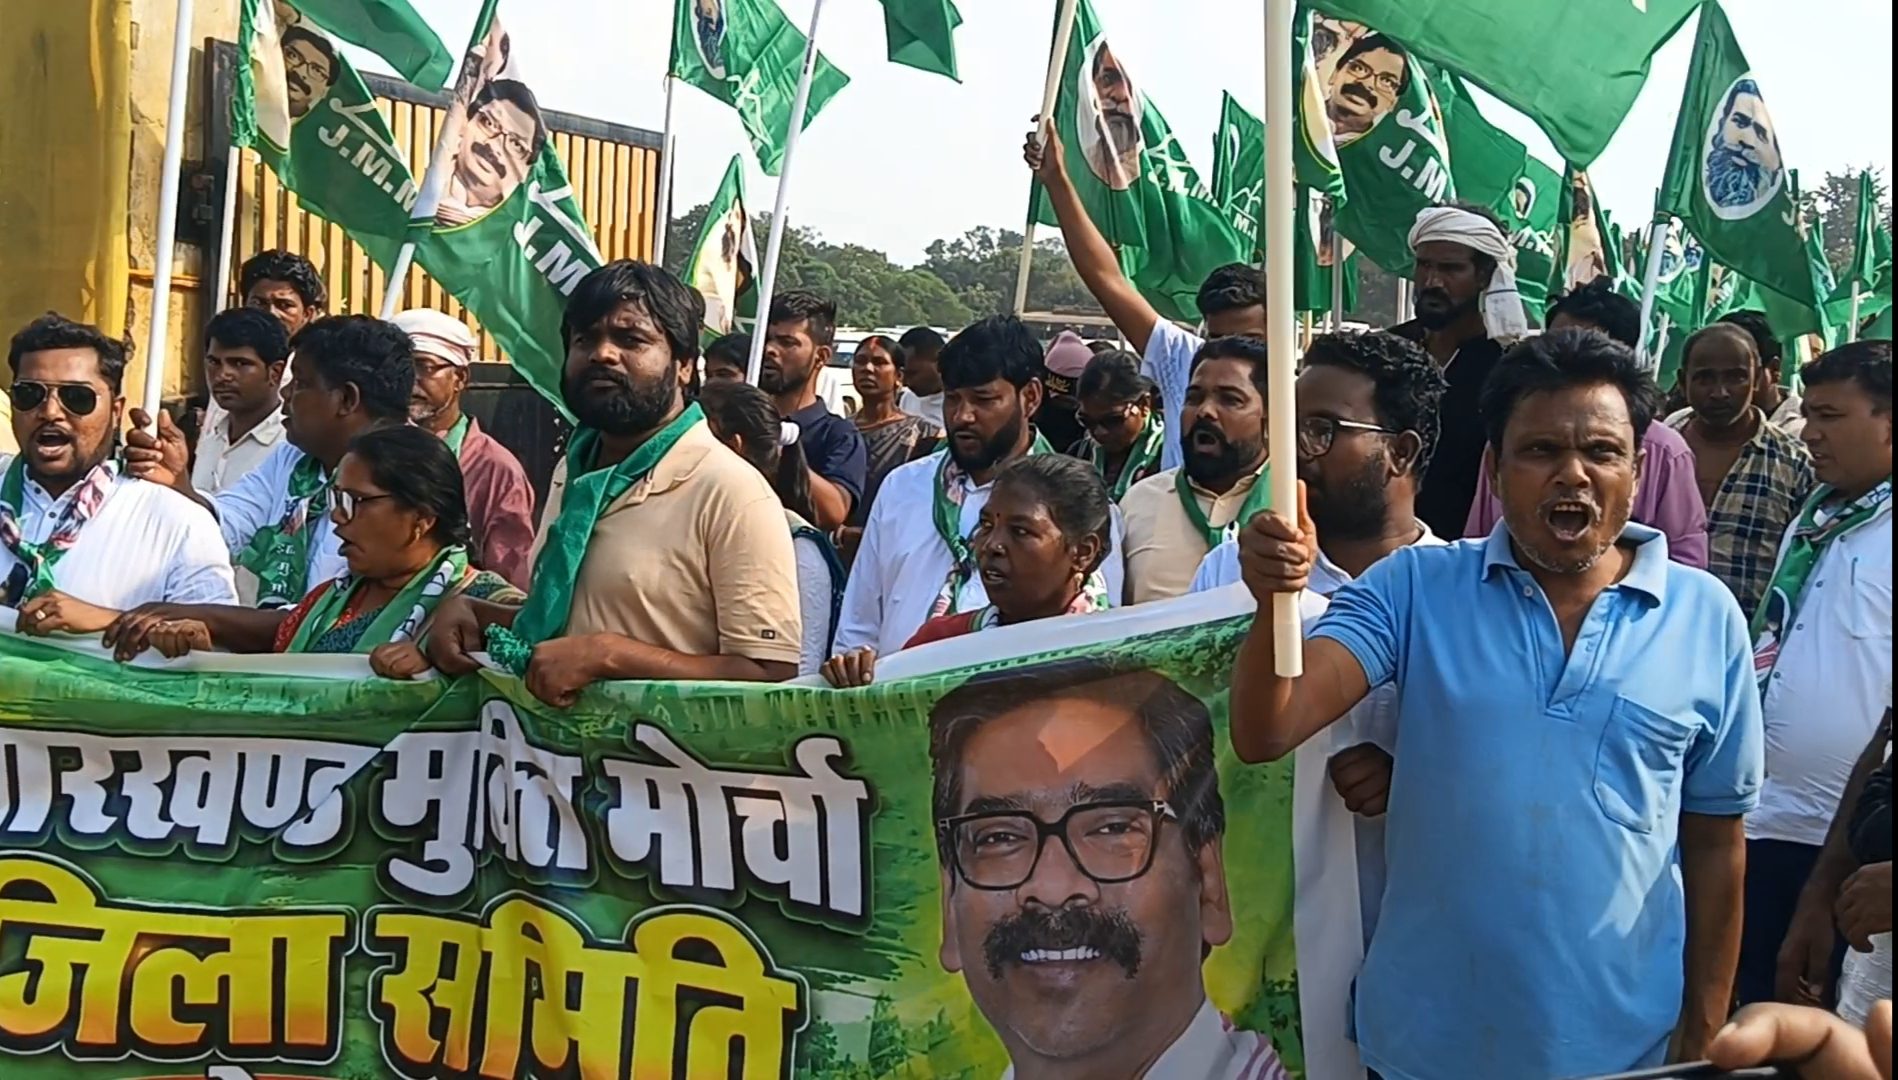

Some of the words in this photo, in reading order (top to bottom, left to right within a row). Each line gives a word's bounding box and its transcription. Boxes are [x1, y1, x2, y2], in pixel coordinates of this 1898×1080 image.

[0, 728, 381, 846] ारखण्ड
[383, 700, 587, 896] मुक्ति
[602, 723, 868, 916] मोर्चा
[376, 900, 798, 1080] समिति
